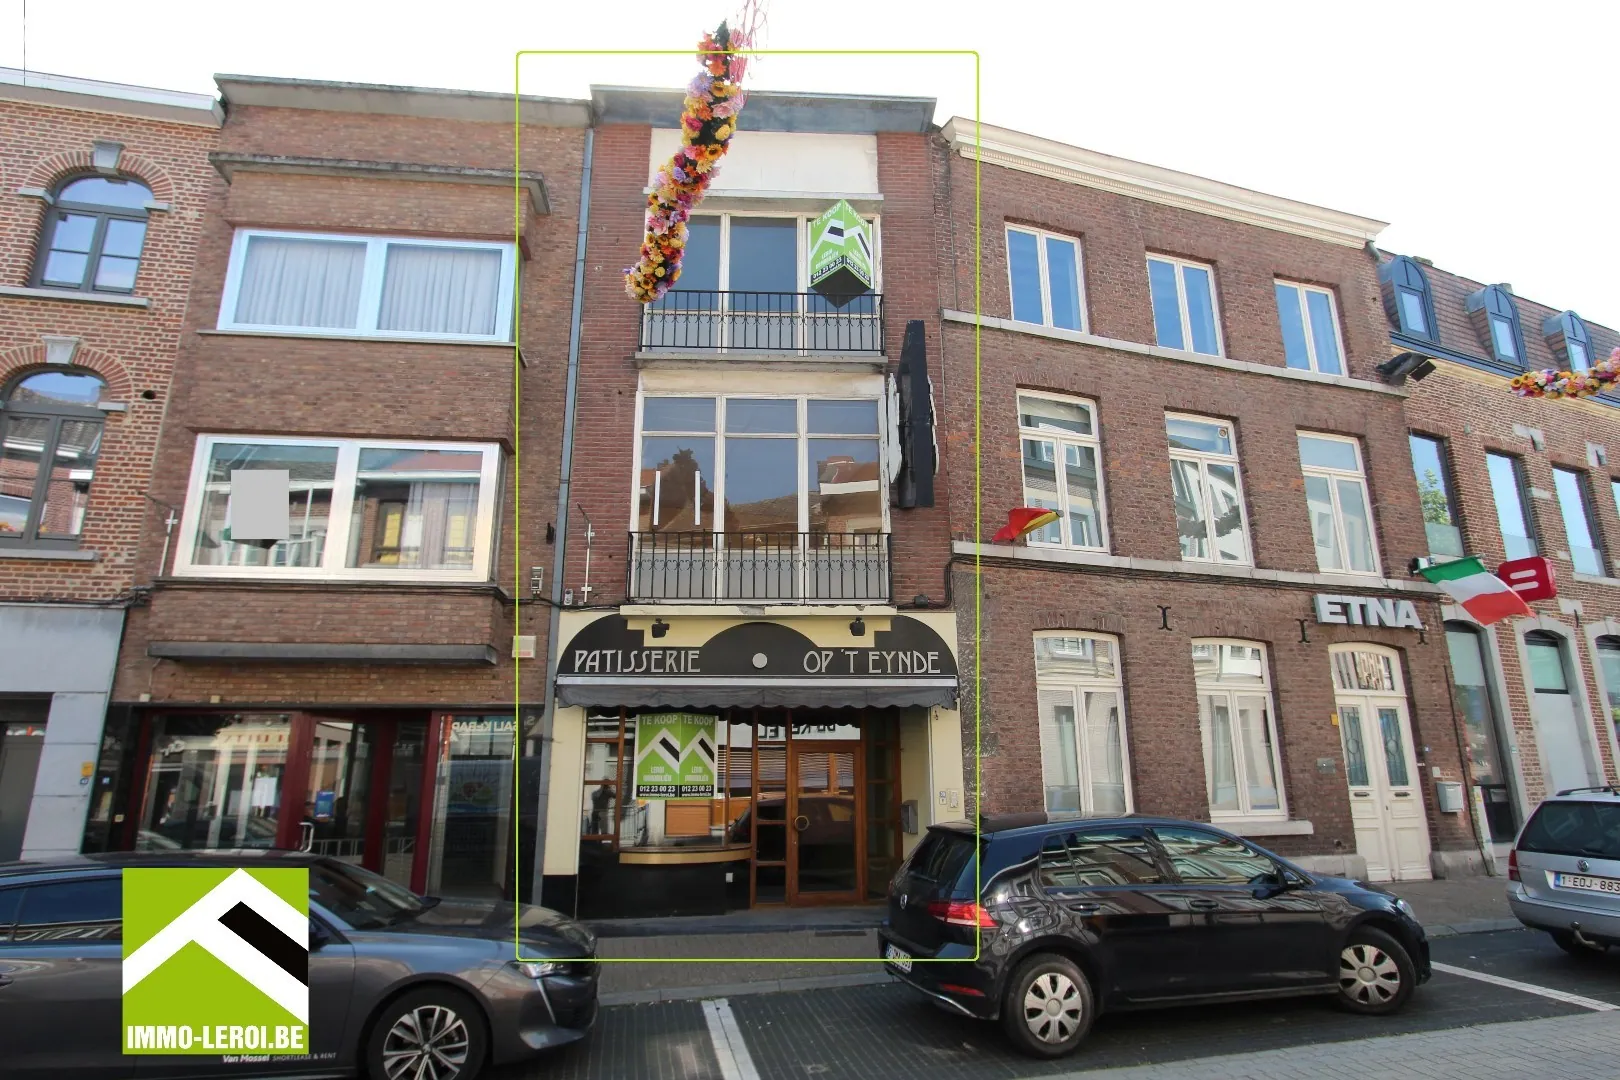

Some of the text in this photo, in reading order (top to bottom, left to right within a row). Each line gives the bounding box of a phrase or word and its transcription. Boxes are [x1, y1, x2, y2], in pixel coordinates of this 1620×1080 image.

[813, 202, 842, 228] TE KOOP
[1313, 593, 1423, 629] ETNA
[574, 650, 700, 673] PATISSERIE
[803, 649, 940, 674] OP 'T EYNDE
[642, 715, 678, 725] TE KOOP
[683, 715, 714, 726] TE KOOP
[223, 1055, 238, 1063] Van
[240, 1054, 269, 1063] Mossel
[320, 1052, 337, 1060] RENT
